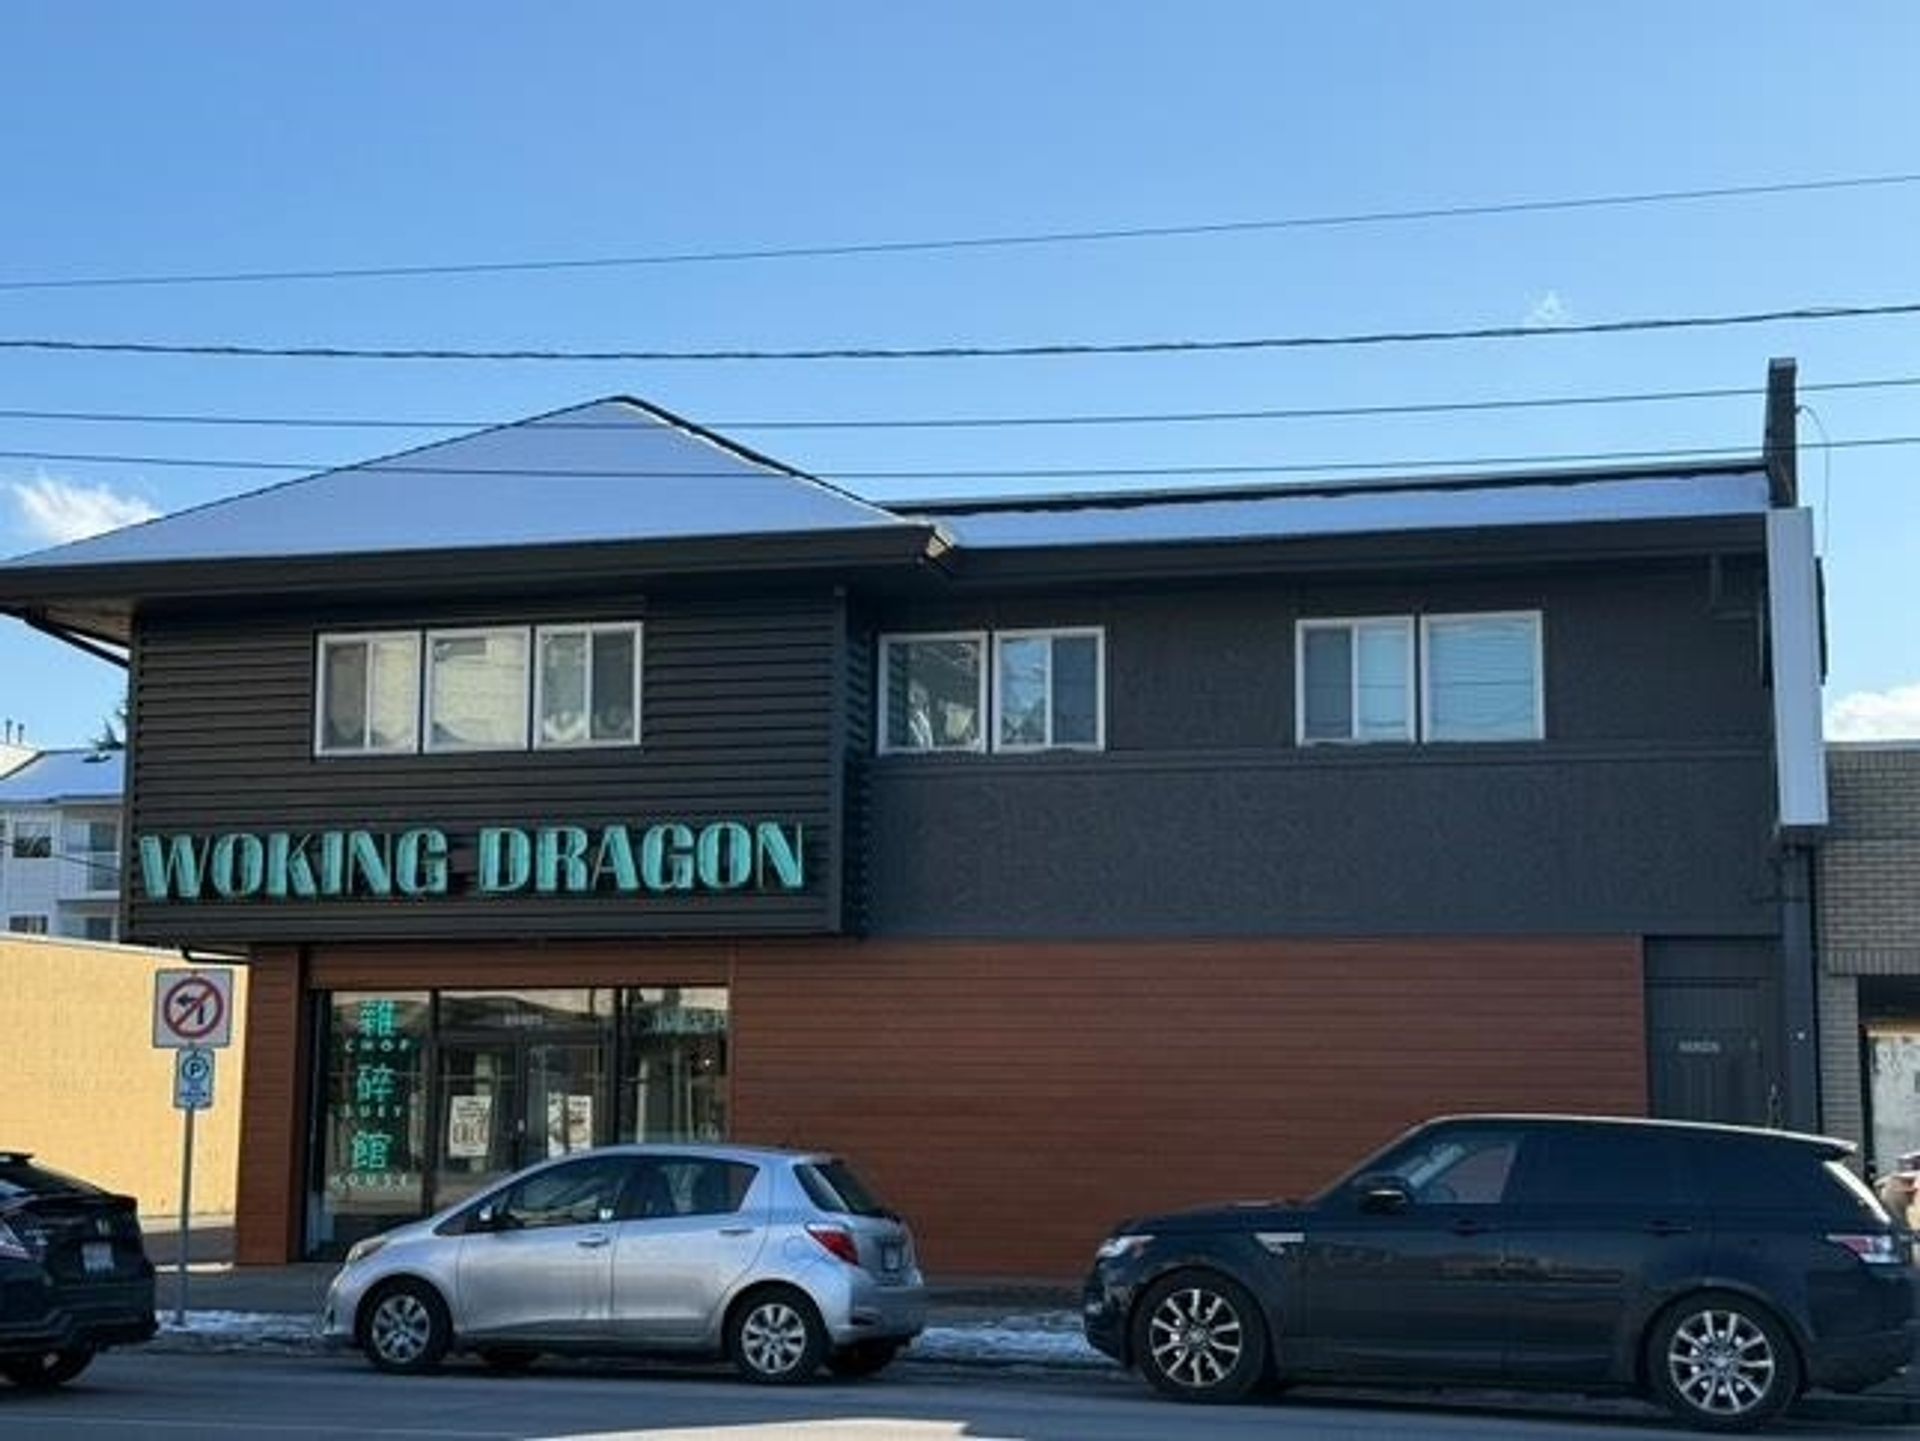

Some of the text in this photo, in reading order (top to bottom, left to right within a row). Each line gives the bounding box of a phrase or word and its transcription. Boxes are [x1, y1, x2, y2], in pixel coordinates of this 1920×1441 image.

[138, 821, 804, 898] WOKING DRAGON
[344, 1038, 410, 1052] CHOP
